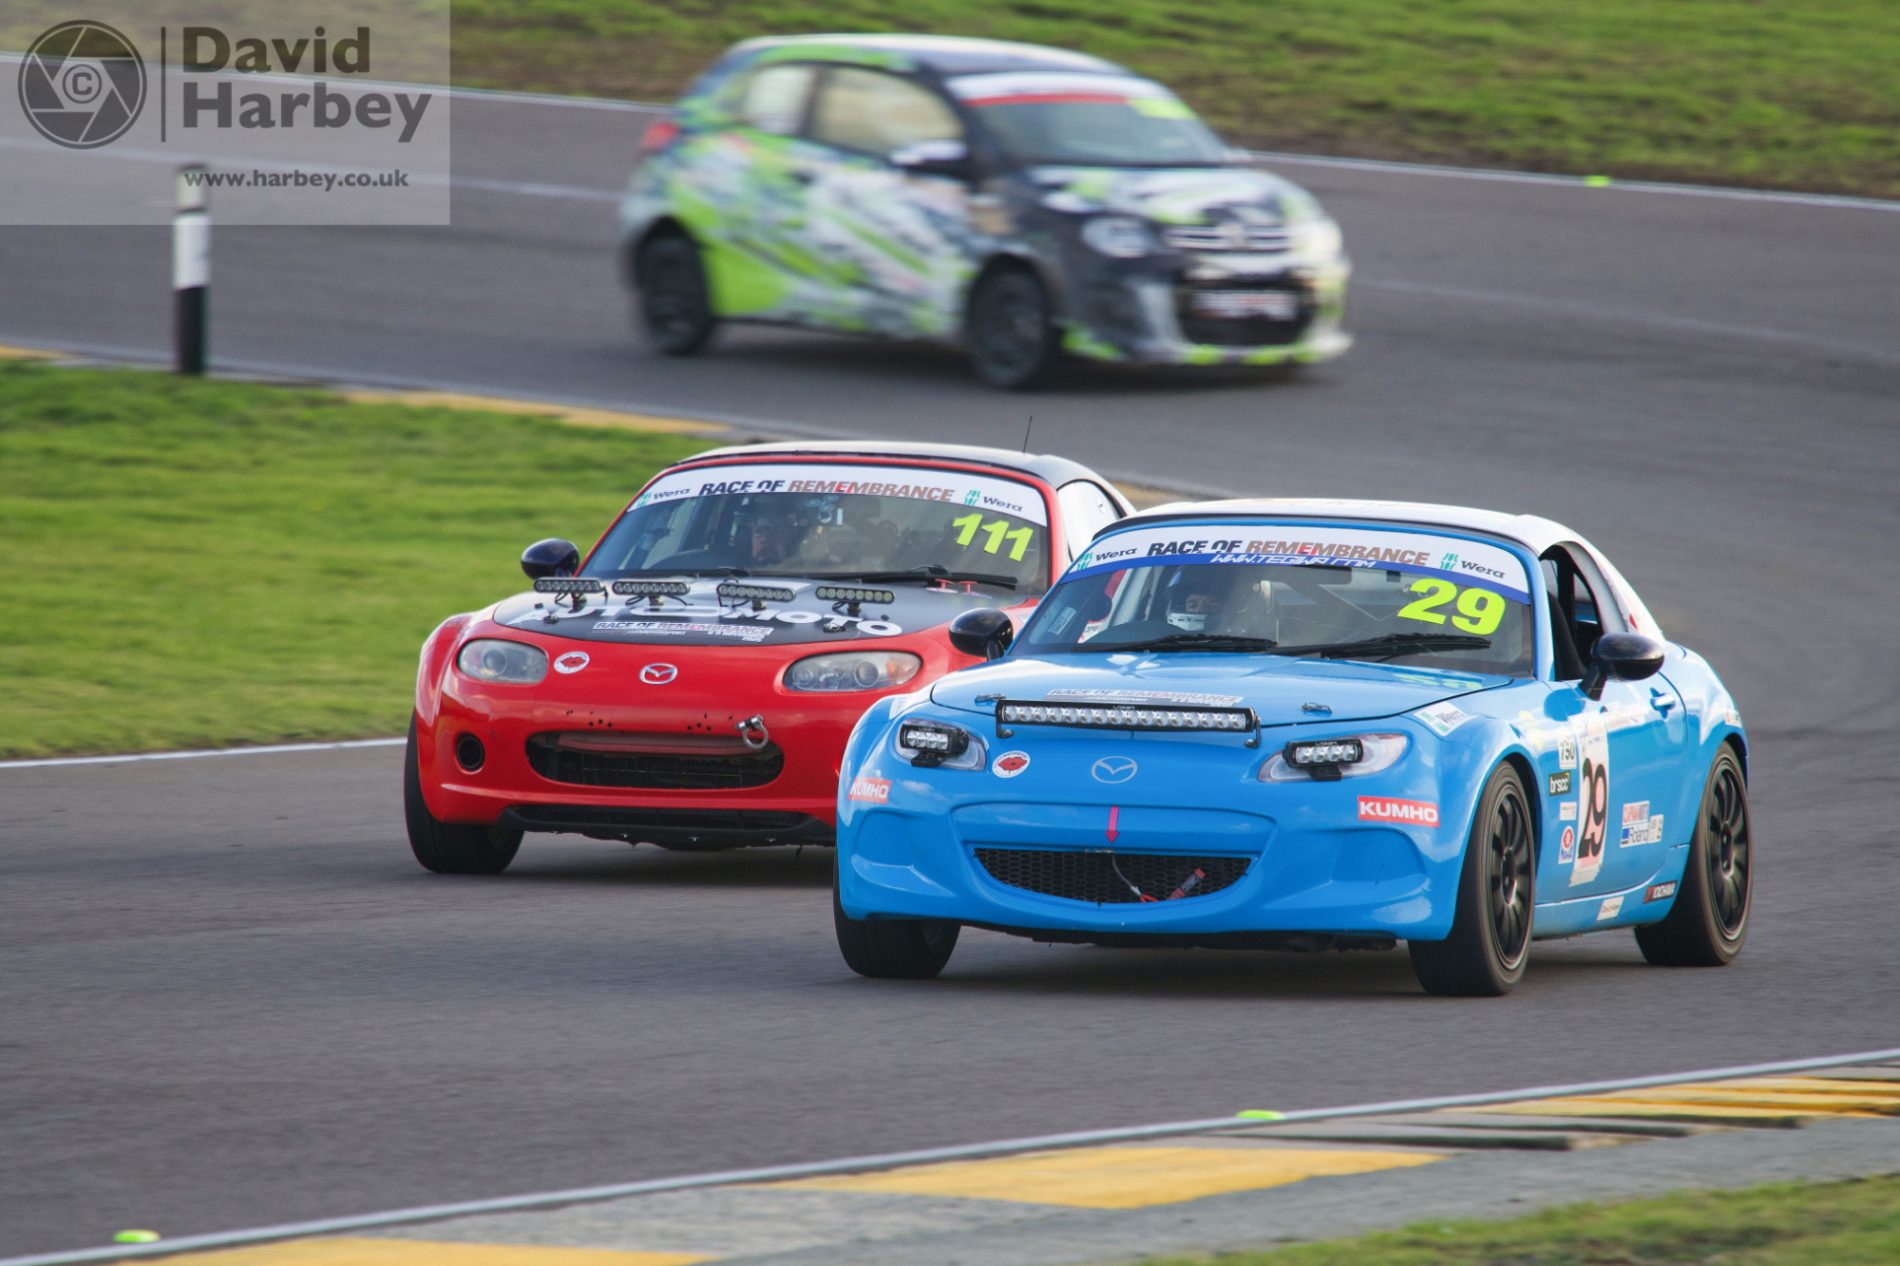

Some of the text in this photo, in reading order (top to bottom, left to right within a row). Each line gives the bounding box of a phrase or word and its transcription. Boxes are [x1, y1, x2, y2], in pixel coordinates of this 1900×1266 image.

[653, 487, 691, 500] Wera
[700, 479, 955, 501] RACE OF REMEMBRANCE
[983, 496, 1023, 512] Wera
[952, 513, 1035, 562] 111
[1096, 548, 1138, 562] Wera
[1147, 540, 1430, 566] RACE OF REMEMBRANCE
[1211, 554, 1376, 568] WWW.TEGIWACOM
[1461, 559, 1506, 579] Wera
[1397, 577, 1506, 635] 29
[850, 782, 888, 799] KUMHO
[1359, 801, 1439, 822] KUMHO
[1578, 757, 1607, 859] 29
